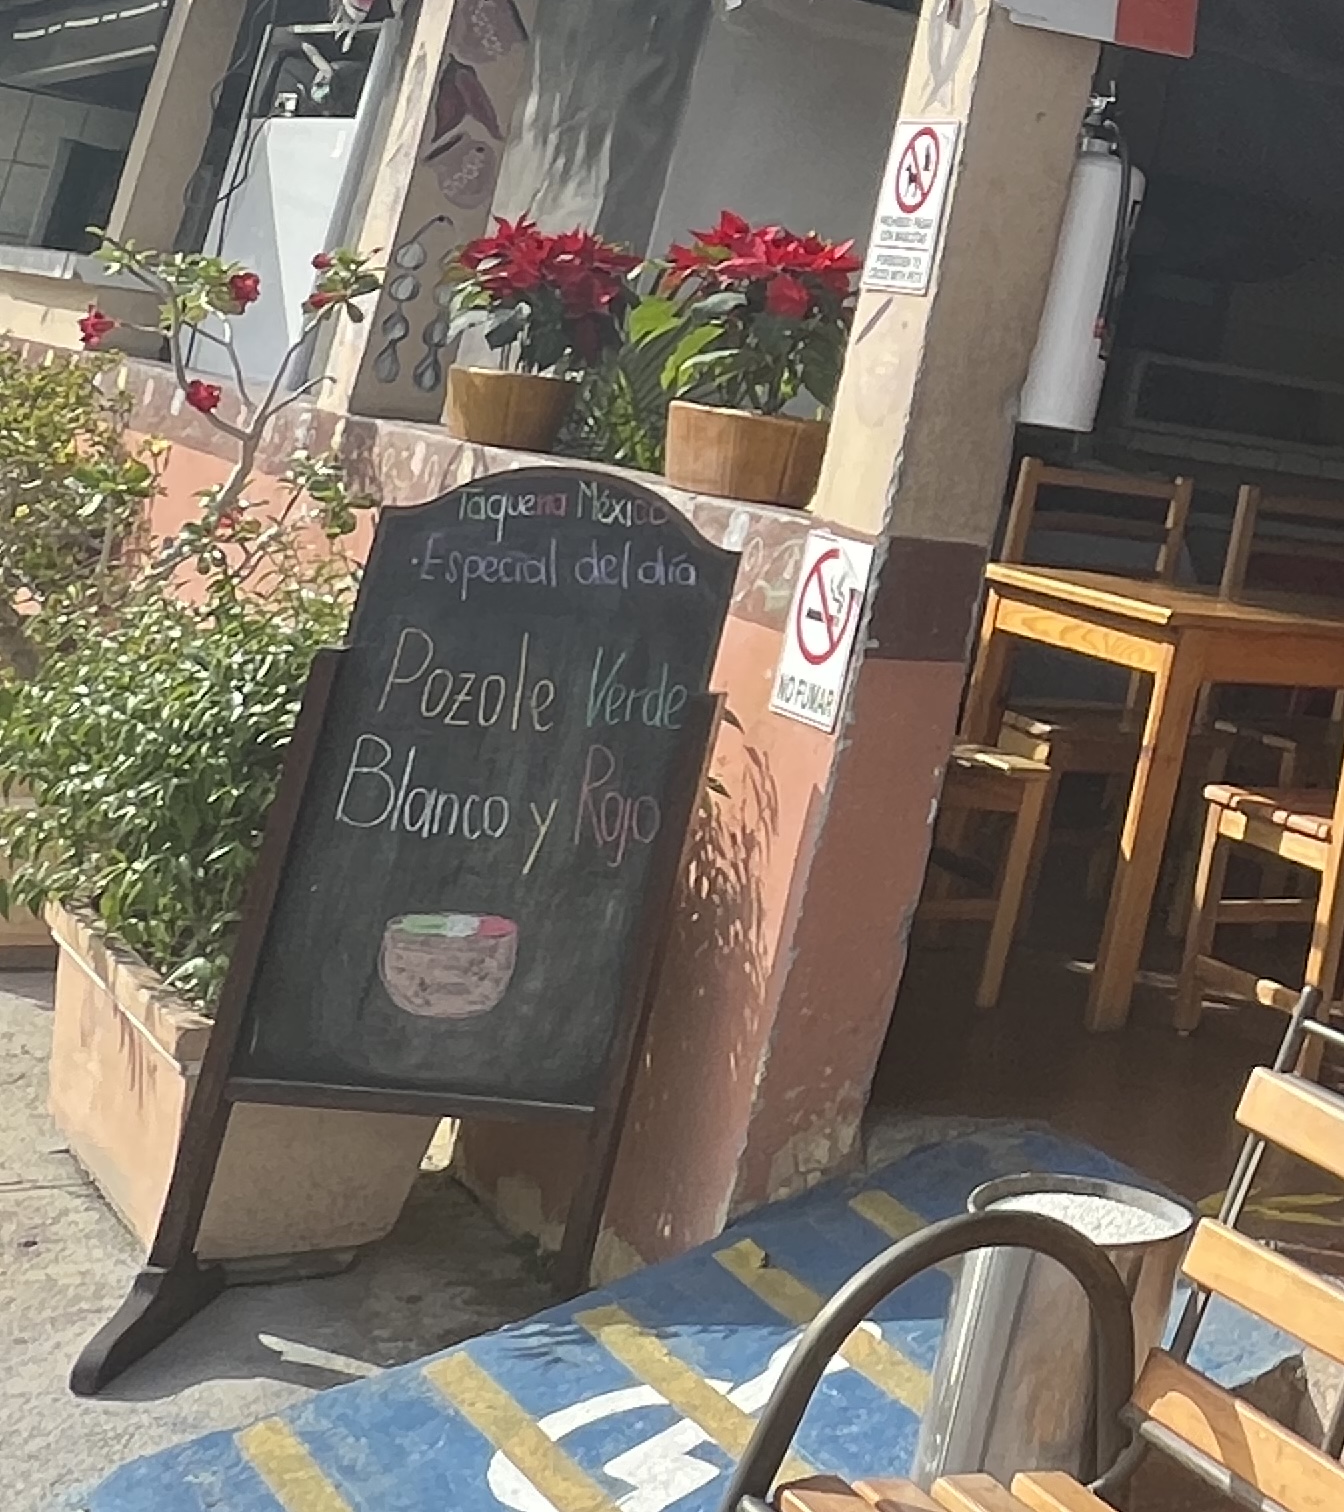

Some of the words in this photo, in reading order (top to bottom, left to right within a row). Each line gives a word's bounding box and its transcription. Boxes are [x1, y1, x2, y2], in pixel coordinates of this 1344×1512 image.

[419, 534, 558, 601] Especial
[574, 538, 632, 589] del
[637, 545, 698, 586] día
[376, 627, 556, 731] Pozole
[585, 646, 689, 730] Verde
[777, 673, 795, 704] NO
[795, 679, 835, 717] FUMAR
[335, 733, 510, 840] Blanco
[530, 798, 560, 875] y
[573, 744, 662, 868] Rojo
